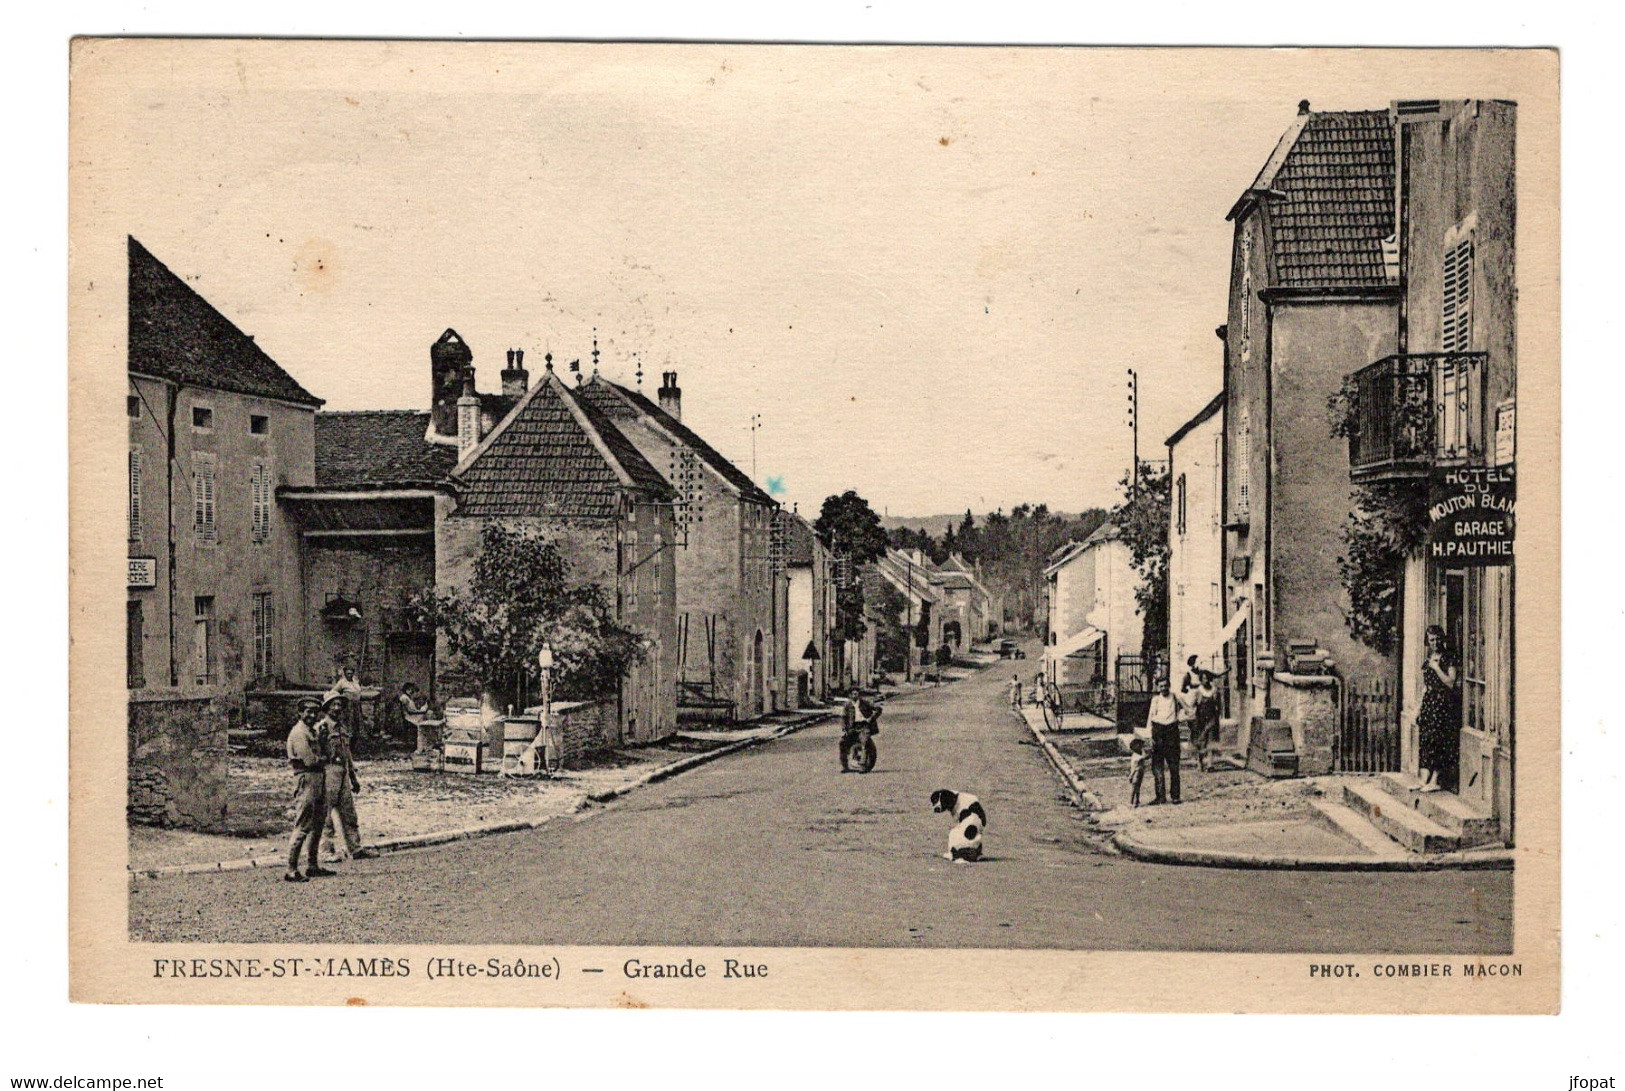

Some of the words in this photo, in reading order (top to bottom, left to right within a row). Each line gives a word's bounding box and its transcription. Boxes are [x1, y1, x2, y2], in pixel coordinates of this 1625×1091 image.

[1464, 484, 1490, 494] DU
[1428, 494, 1476, 523] MOUTON
[1454, 521, 1505, 537] GARAGE
[153, 957, 410, 978] FRESNE-ST-MAMÈS
[427, 957, 560, 980] (Hte-Saône)
[623, 958, 706, 979] Grande
[723, 959, 768, 978] Rue
[1309, 963, 1361, 978] PHOT.
[1373, 963, 1452, 978] COMBIER
[1463, 963, 1522, 978] MACON
